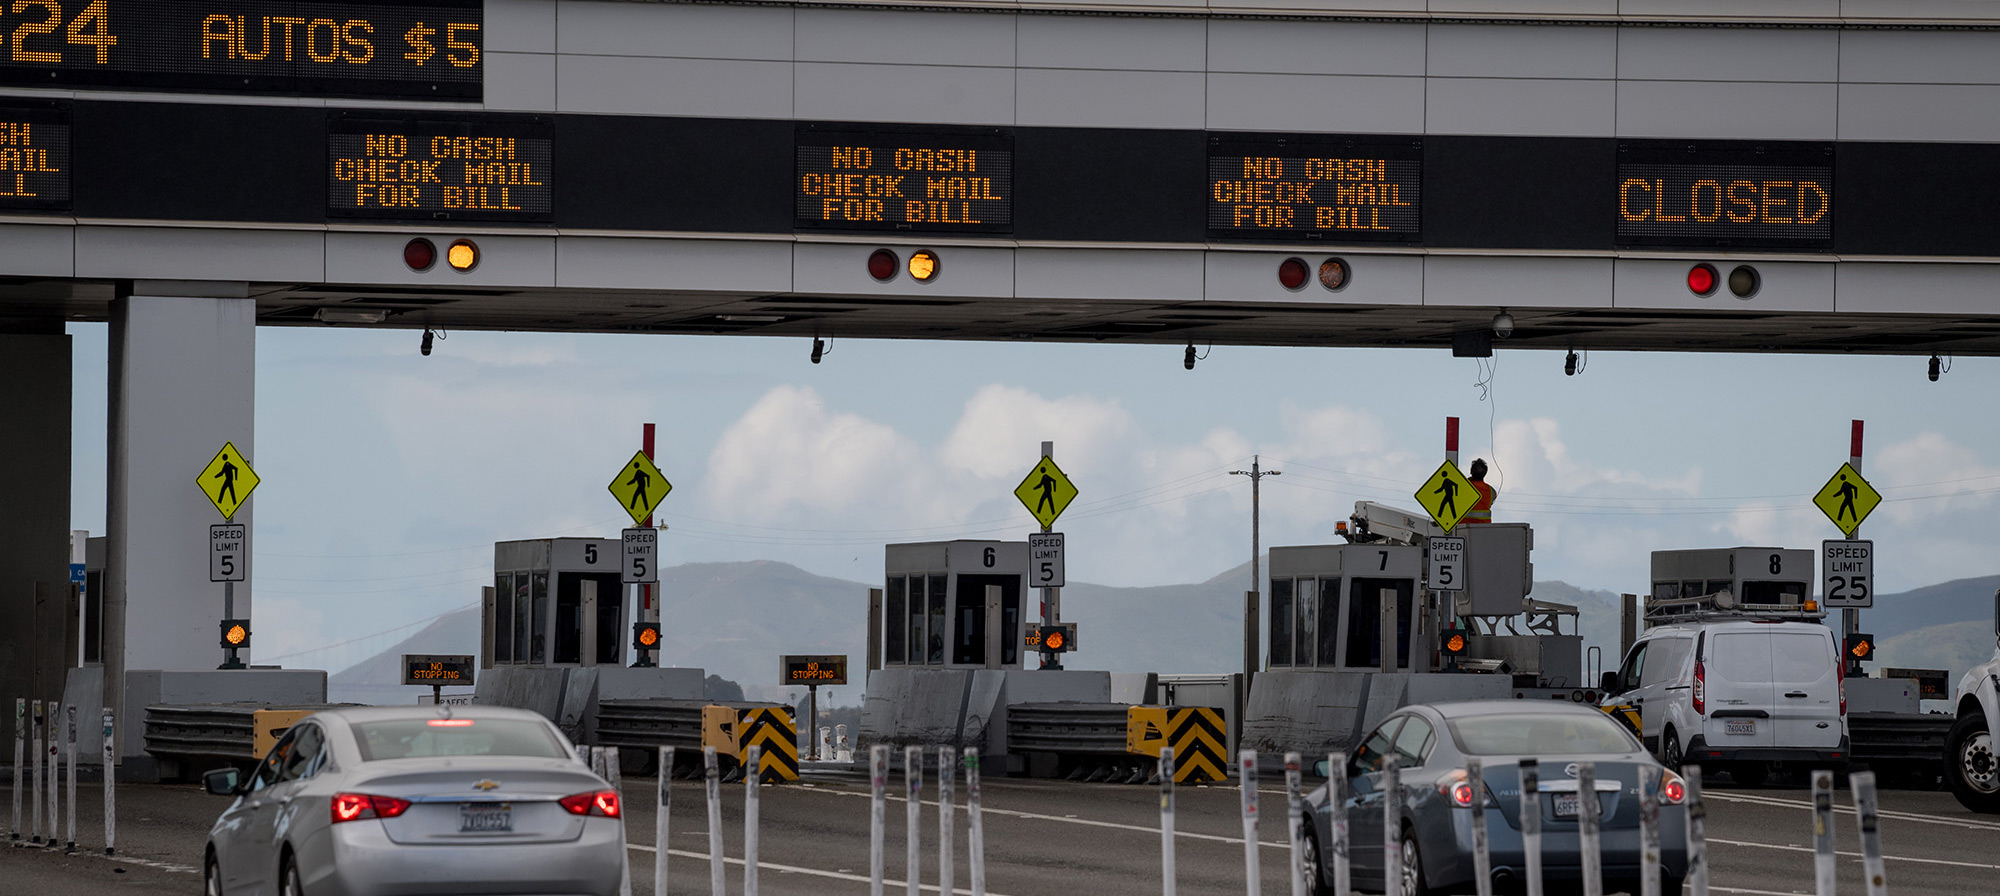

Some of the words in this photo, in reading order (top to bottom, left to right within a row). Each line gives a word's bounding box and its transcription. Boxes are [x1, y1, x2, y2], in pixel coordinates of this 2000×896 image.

[0, 0, 116, 63] 24
[203, 15, 373, 63] AUTOS
[405, 22, 478, 67] $5
[367, 135, 407, 157] NO
[432, 136, 514, 159] CASH
[833, 147, 871, 168] NO
[896, 149, 975, 171] CASH
[336, 159, 440, 182] CHECK
[466, 162, 542, 185] MAIL
[1244, 157, 1282, 178] NO
[1306, 159, 1384, 181] CASH
[803, 174, 904, 199] CHECK
[928, 177, 1001, 199] MAIL
[1215, 181, 1314, 203] CHECK
[1338, 183, 1410, 205] MAIL
[357, 184, 419, 207] FOR
[444, 186, 520, 209] BILL
[1621, 179, 1827, 223] CLOSED
[824, 198, 883, 221] FOR
[907, 201, 980, 223] BILL
[1235, 205, 1293, 227] FOR
[1317, 207, 1389, 229] BILL
[213, 531, 243, 539] SPEED
[625, 535, 655, 543] SPEED
[1032, 539, 1061, 547] SPEED
[216, 543, 239, 551] LIMIT
[585, 544, 598, 564] 5
[628, 546, 651, 554] LIMIT
[1035, 551, 1058, 559] LIMIT
[1432, 542, 1462, 551] SPEED
[1828, 548, 1868, 558] SPEED
[221, 555, 234, 575] 5
[983, 547, 996, 568] 6
[1379, 551, 1388, 571] 7
[1435, 554, 1458, 562] LIMIT
[1769, 554, 1781, 575] 8
[1832, 562, 1863, 572] LIMIT
[633, 558, 646, 577] 5
[1041, 562, 1053, 581] 5
[1440, 566, 1452, 584] 5
[1828, 576, 1868, 600] 25
[414, 670, 459, 679] STOPPING
[430, 661, 443, 670] NO
[793, 670, 834, 679] STOPPING
[807, 662, 819, 671] NO
